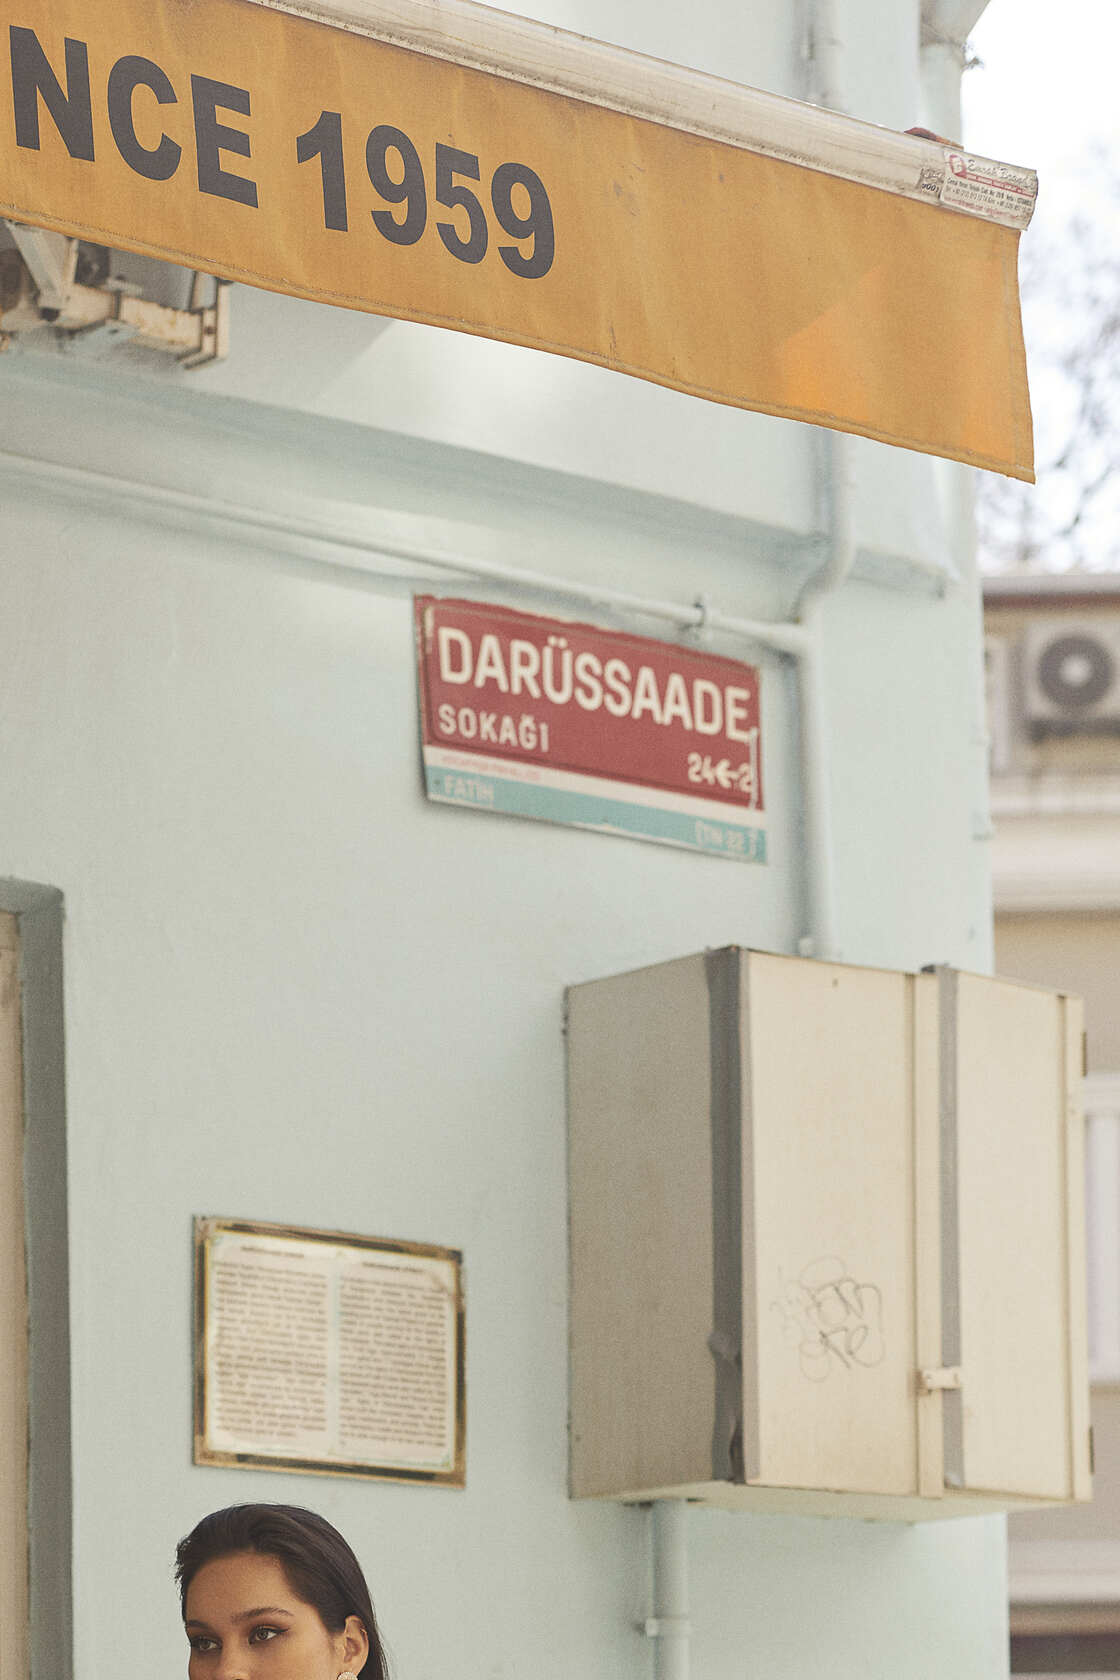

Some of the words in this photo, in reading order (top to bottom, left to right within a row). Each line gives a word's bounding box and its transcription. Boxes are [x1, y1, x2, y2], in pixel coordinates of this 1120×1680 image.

[295, 109, 555, 280] 1959
[438, 626, 752, 744] DARÜSSAADE
[438, 703, 550, 752] SOKAĞI
